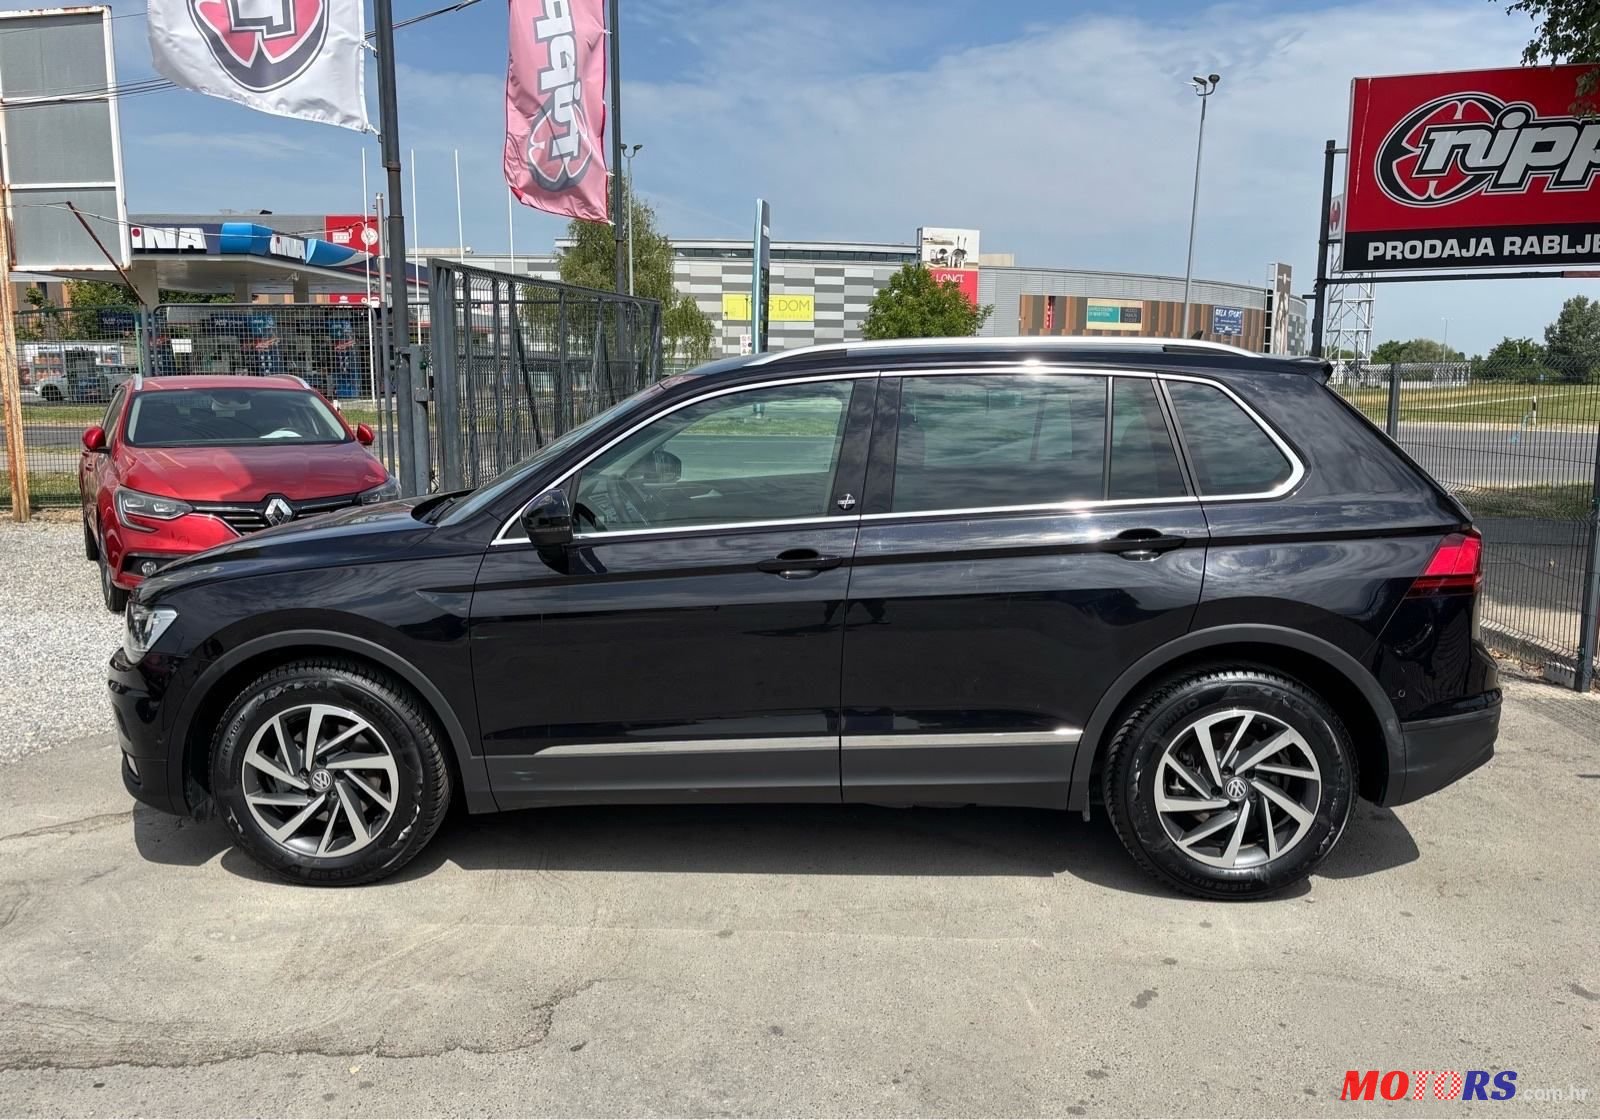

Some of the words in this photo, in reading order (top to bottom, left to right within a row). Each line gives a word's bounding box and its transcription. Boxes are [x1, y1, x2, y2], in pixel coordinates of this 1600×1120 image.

[131, 226, 208, 250] INA
[270, 233, 307, 262] INA
[1367, 236, 1496, 261] PRODAJA
[778, 299, 810, 312] DOM
